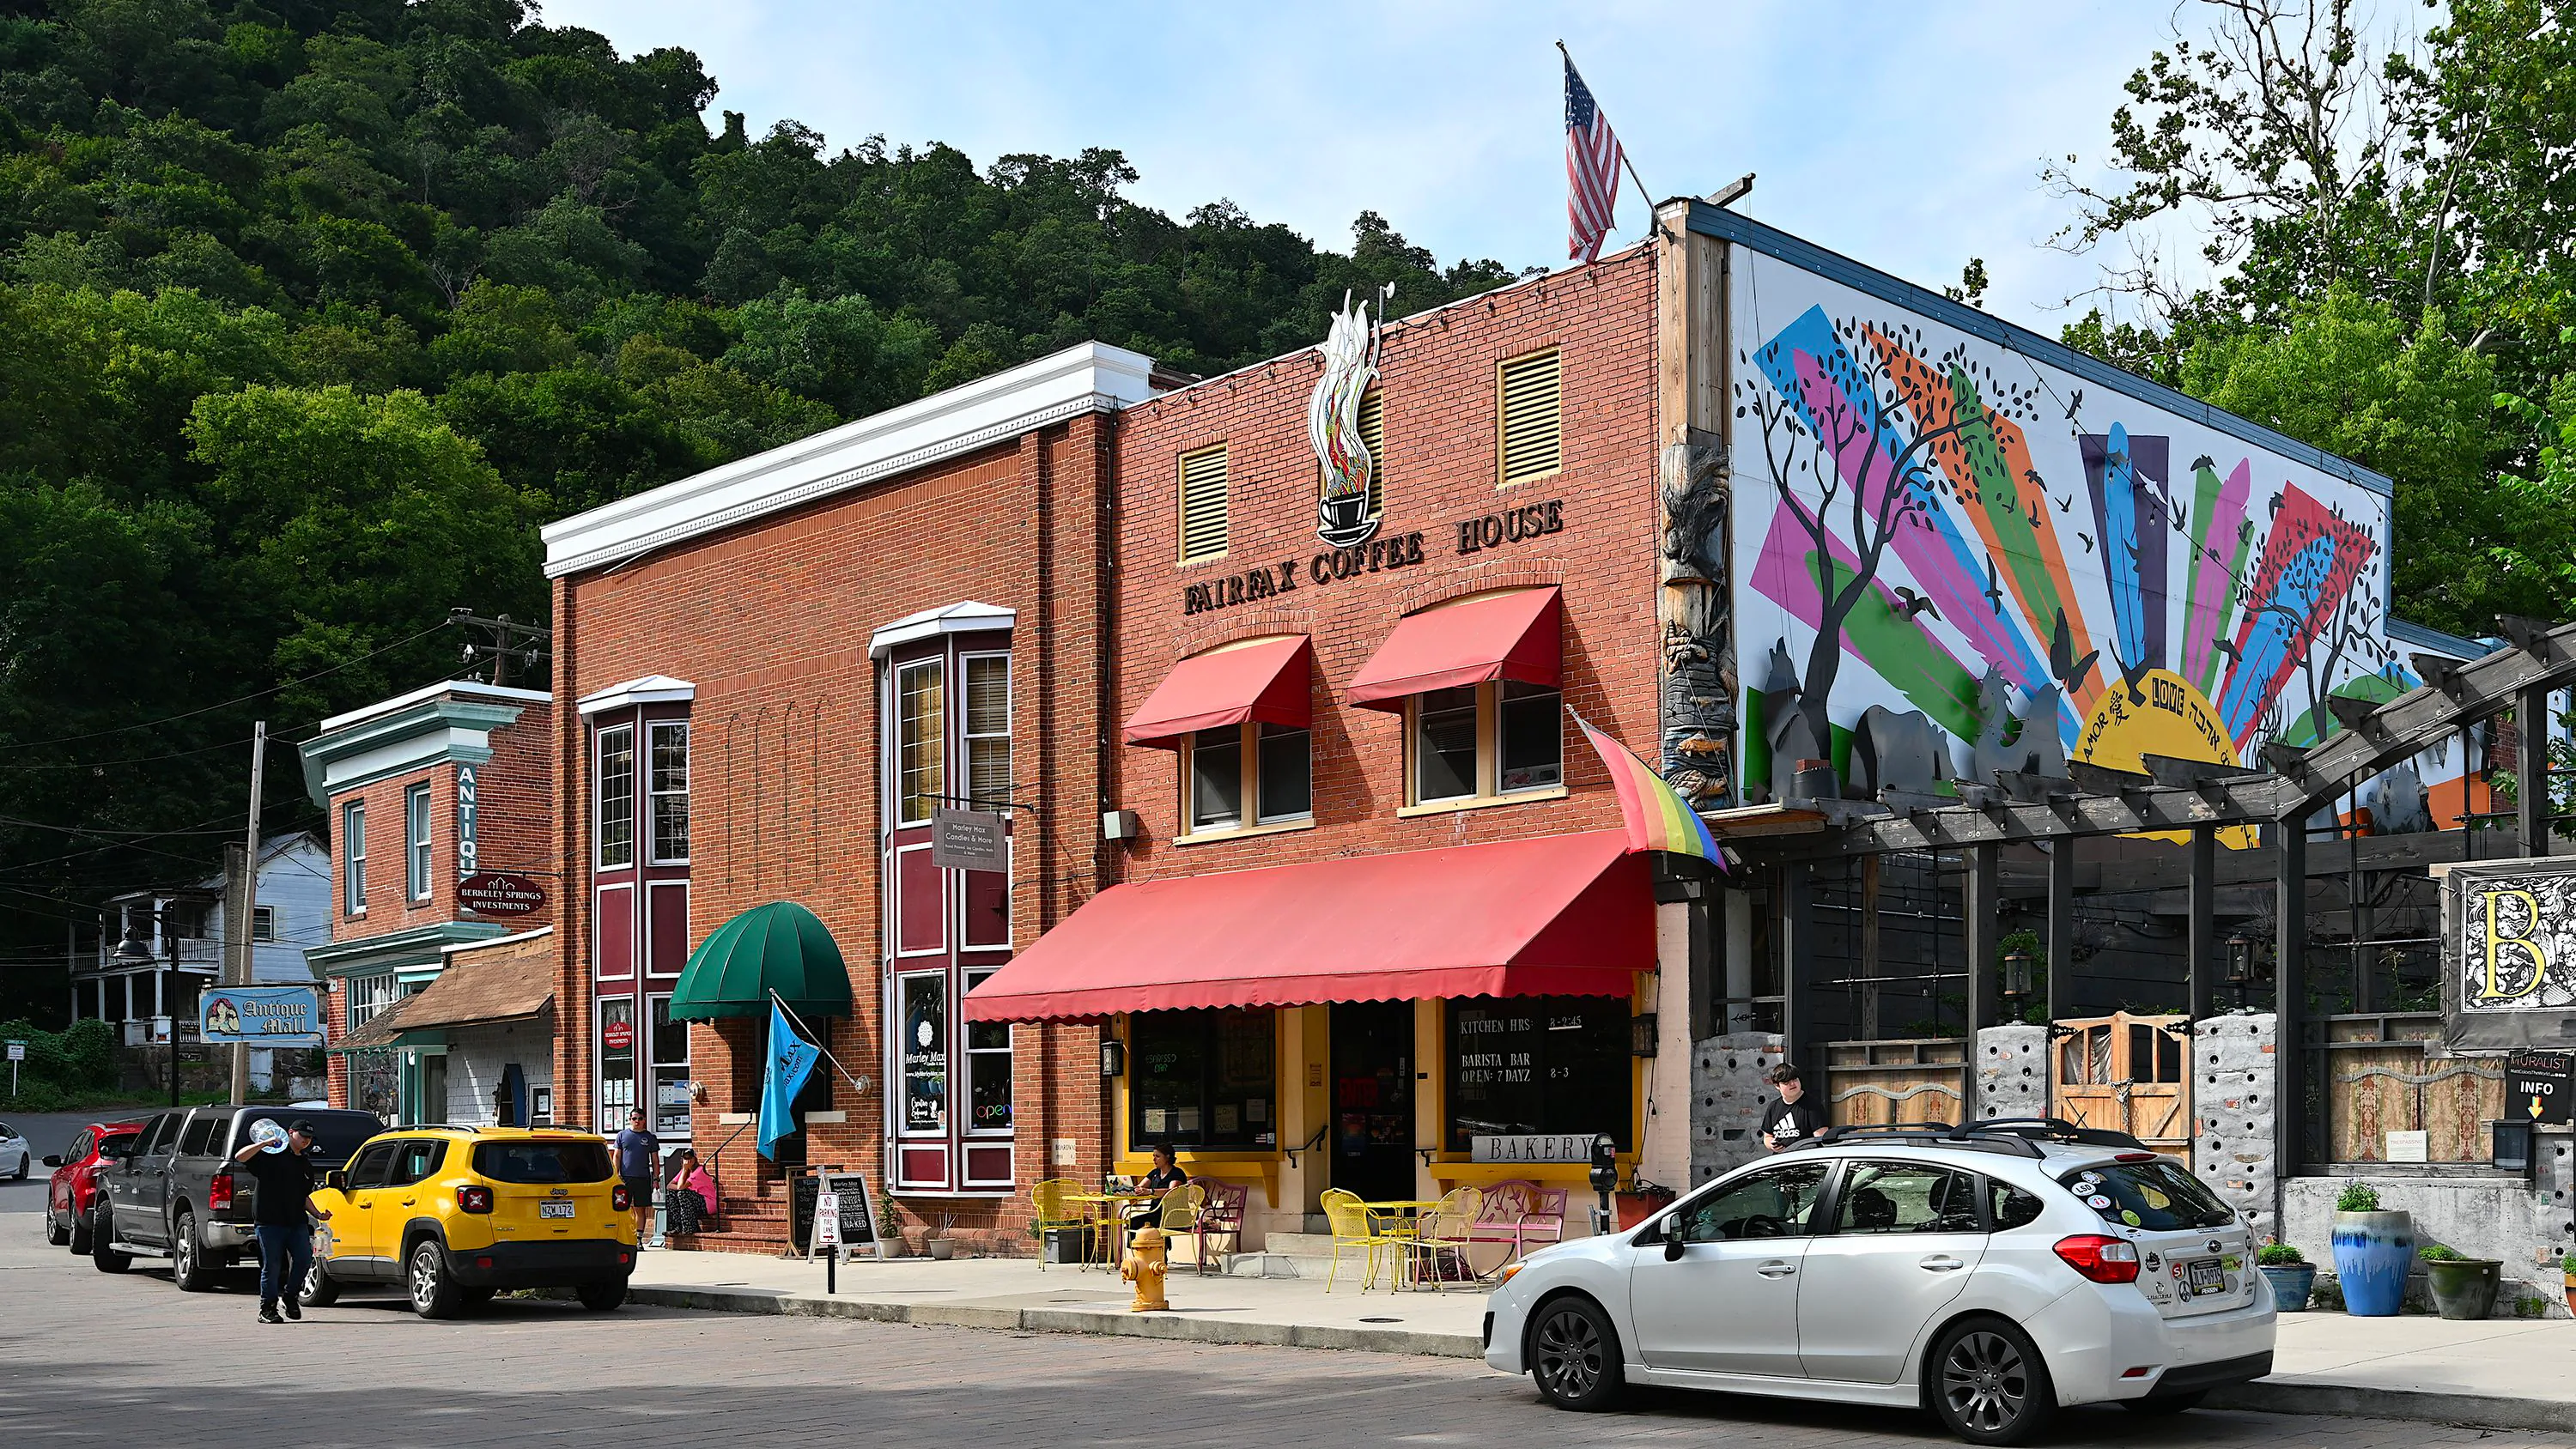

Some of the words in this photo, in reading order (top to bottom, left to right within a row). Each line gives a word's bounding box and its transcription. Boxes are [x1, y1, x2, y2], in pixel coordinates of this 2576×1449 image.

[1183, 561, 1297, 615] FAIRFAX
[1310, 532, 1424, 585] COFFEE
[1458, 500, 1564, 555] HOUSE
[2152, 677, 2184, 717] LOVE
[2110, 690, 2129, 726] 愛
[2083, 712, 2109, 763] AMOR
[953, 824, 972, 833] Marley
[946, 833, 969, 841] Candles
[462, 889, 504, 898] BERKELEY
[506, 891, 541, 900] SPRINGS
[473, 901, 530, 910] INVESTMENTS
[2476, 890, 2546, 999] B
[243, 1001, 307, 1019] Antique
[261, 1018, 306, 1034] Mall
[1461, 1020, 1504, 1034] KITCHEN
[1510, 1018, 1533, 1032] HRS:
[906, 1052, 928, 1065] Marley
[1461, 1053, 1502, 1067] BARISTA
[1510, 1052, 1530, 1066] BAR
[2511, 1056, 2567, 1070] MURALIST
[1461, 1070, 1493, 1082] OPEN:
[1498, 1071, 1503, 1082] 7
[1506, 1070, 1531, 1082] DAYZ
[2521, 1082, 2553, 1094] INFO
[976, 1104, 1012, 1119] open
[1491, 1137, 1593, 1160] BAKERY
[2076, 1185, 2092, 1193] LSD
[824, 1197, 832, 1206] NO
[819, 1209, 837, 1218] PARKING
